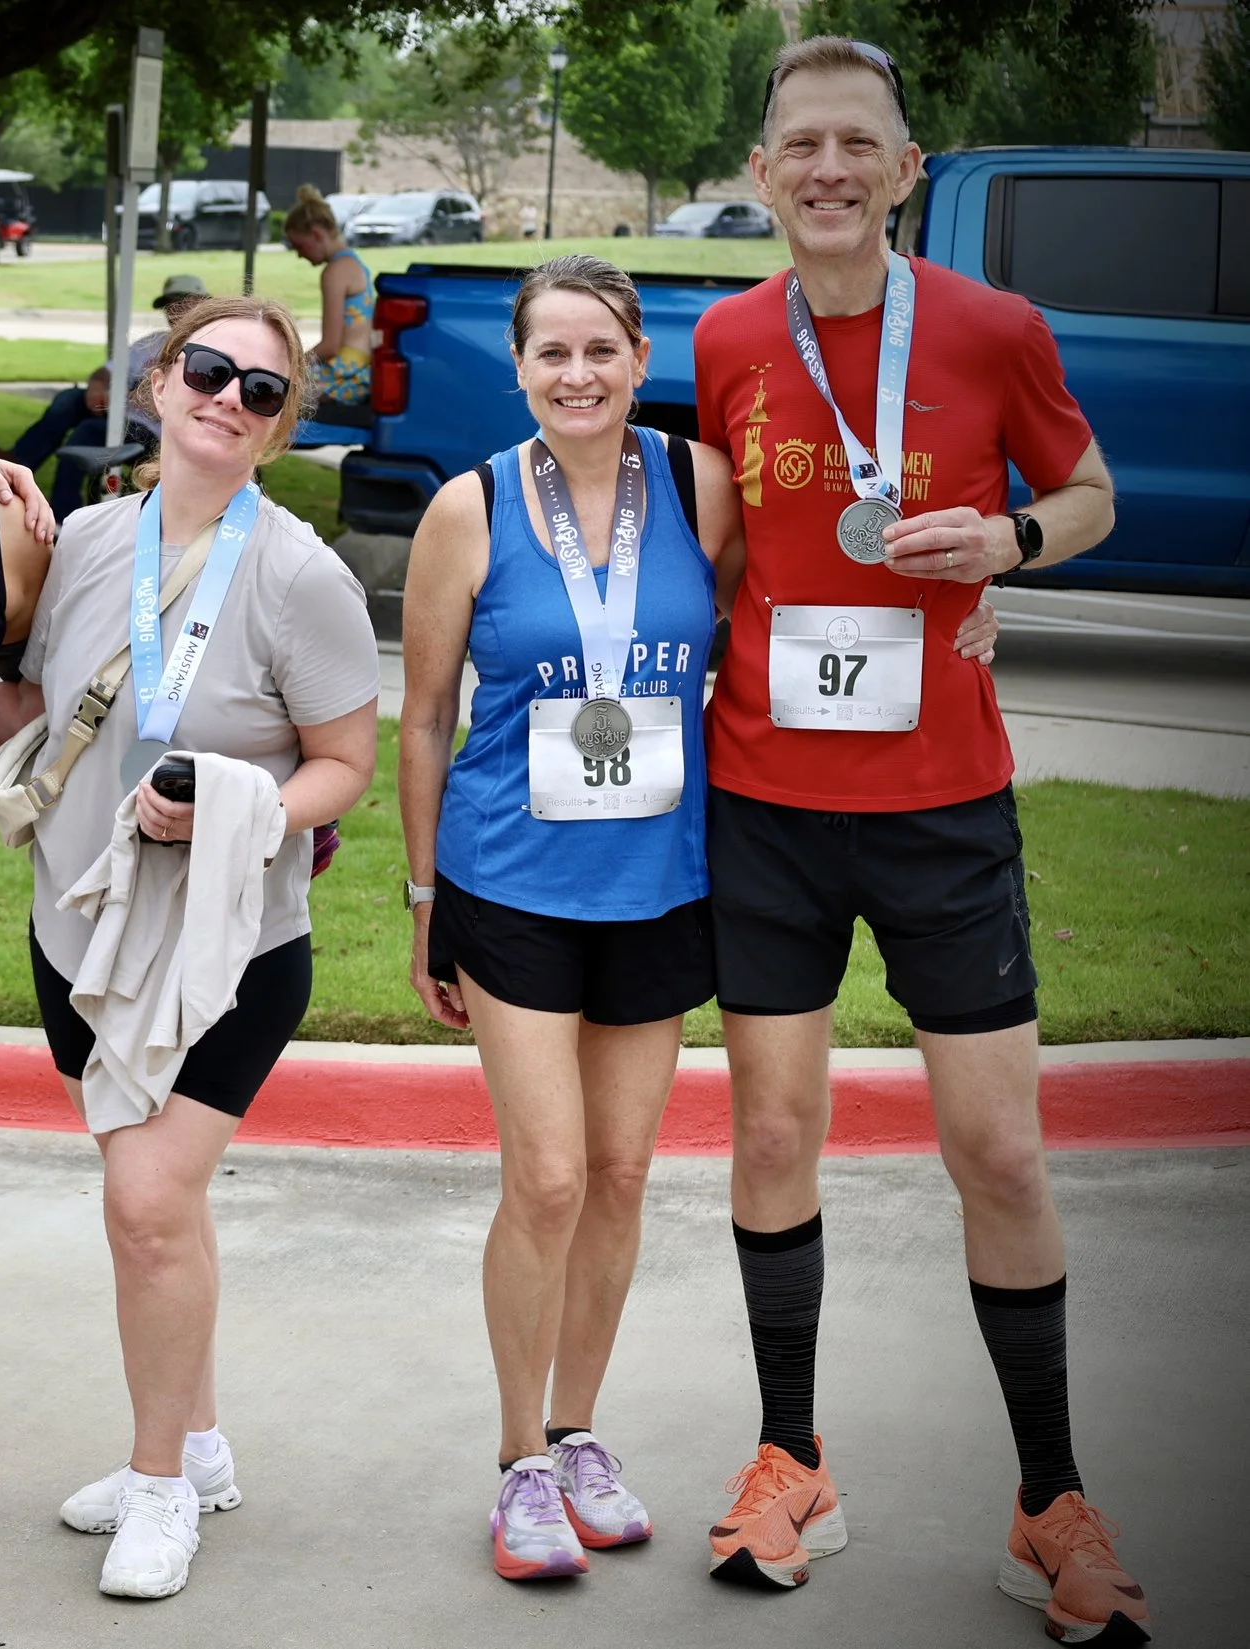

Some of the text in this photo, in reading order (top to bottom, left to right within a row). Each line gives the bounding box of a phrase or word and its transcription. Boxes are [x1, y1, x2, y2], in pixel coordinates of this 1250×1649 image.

[887, 278, 910, 347] MUSTANG
[553, 512, 587, 580] MUSTANG
[613, 508, 637, 577] MUSTANG
[135, 576, 158, 643] MUSTANG
[168, 641, 199, 702] MUSTANG
[536, 642, 691, 687] PRPER
[818, 653, 868, 697] 97
[633, 679, 668, 696] CLUB
[783, 704, 816, 715] Results
[578, 729, 627, 748] MUSTANG
[583, 747, 632, 787] 98
[546, 797, 583, 807] Results
